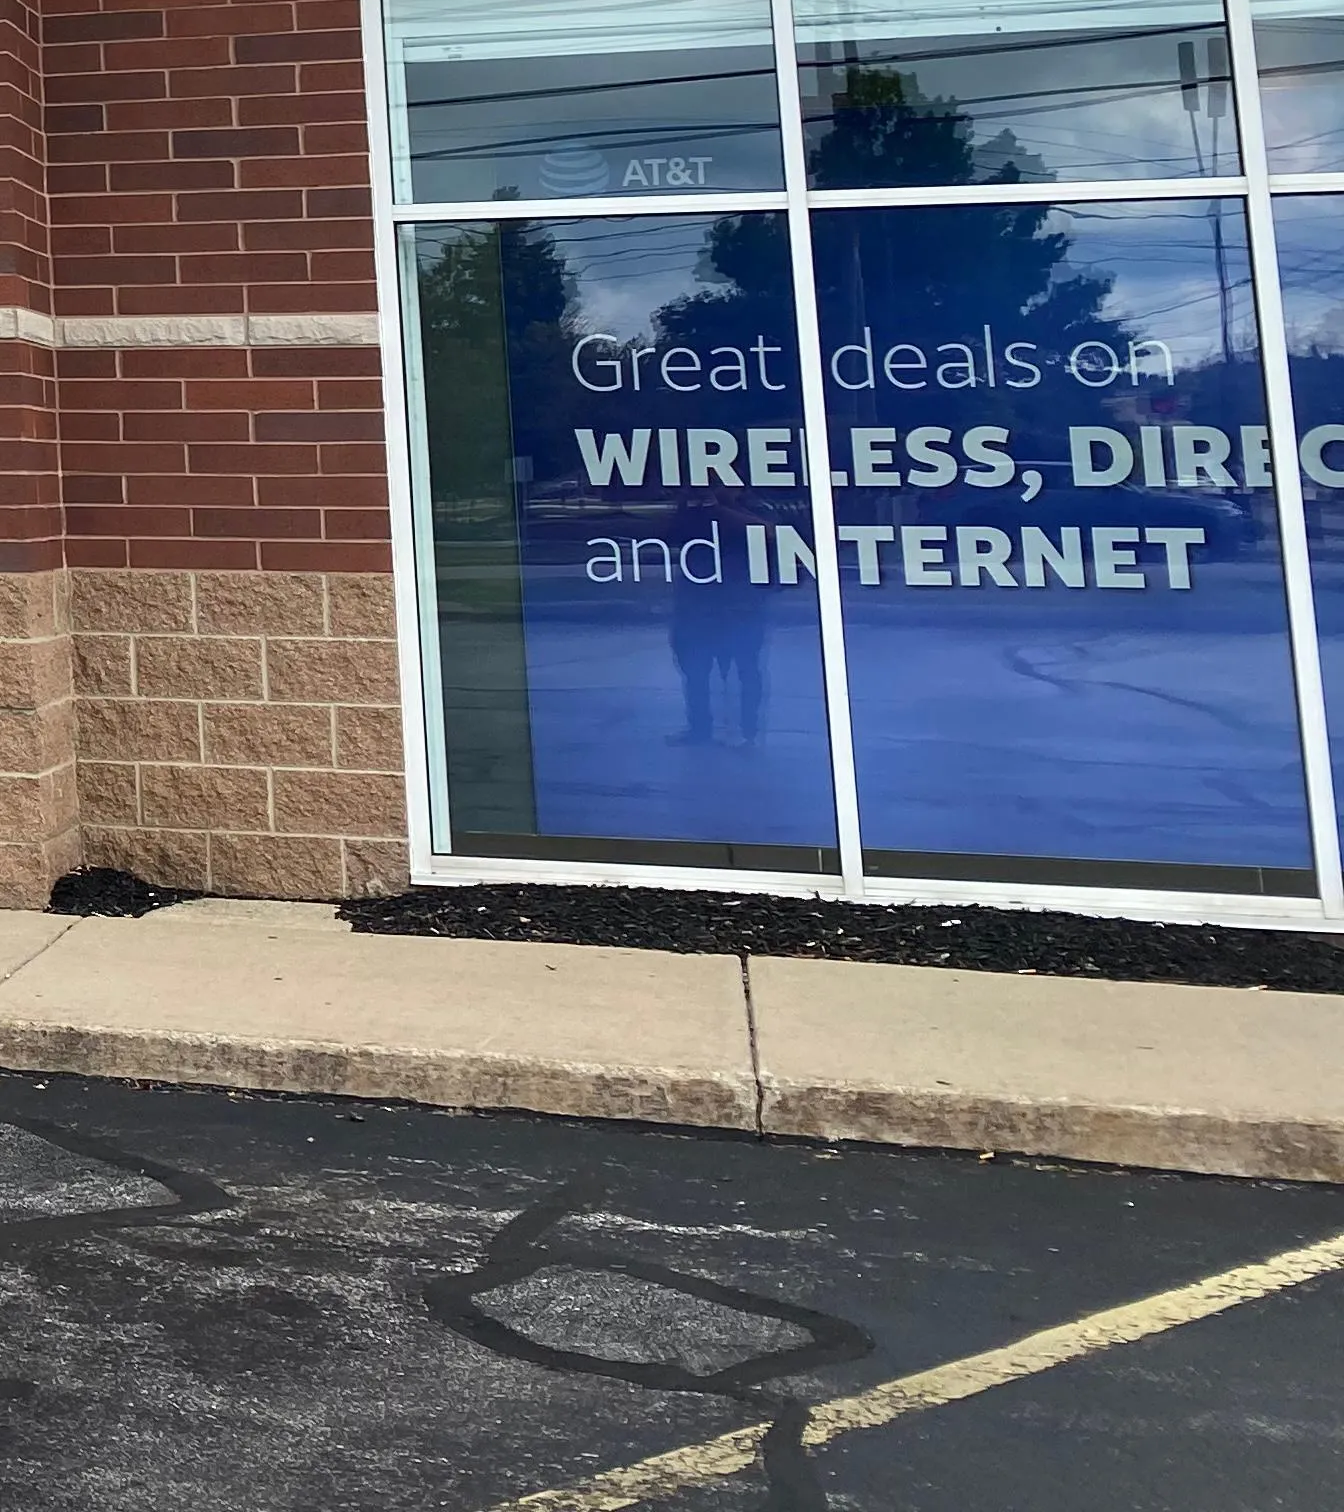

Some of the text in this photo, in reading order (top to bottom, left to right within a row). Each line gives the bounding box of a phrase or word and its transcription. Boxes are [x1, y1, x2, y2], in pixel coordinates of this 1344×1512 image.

[622, 156, 713, 187] AT&T
[571, 324, 1174, 392] Great deals on
[584, 520, 723, 584] and
